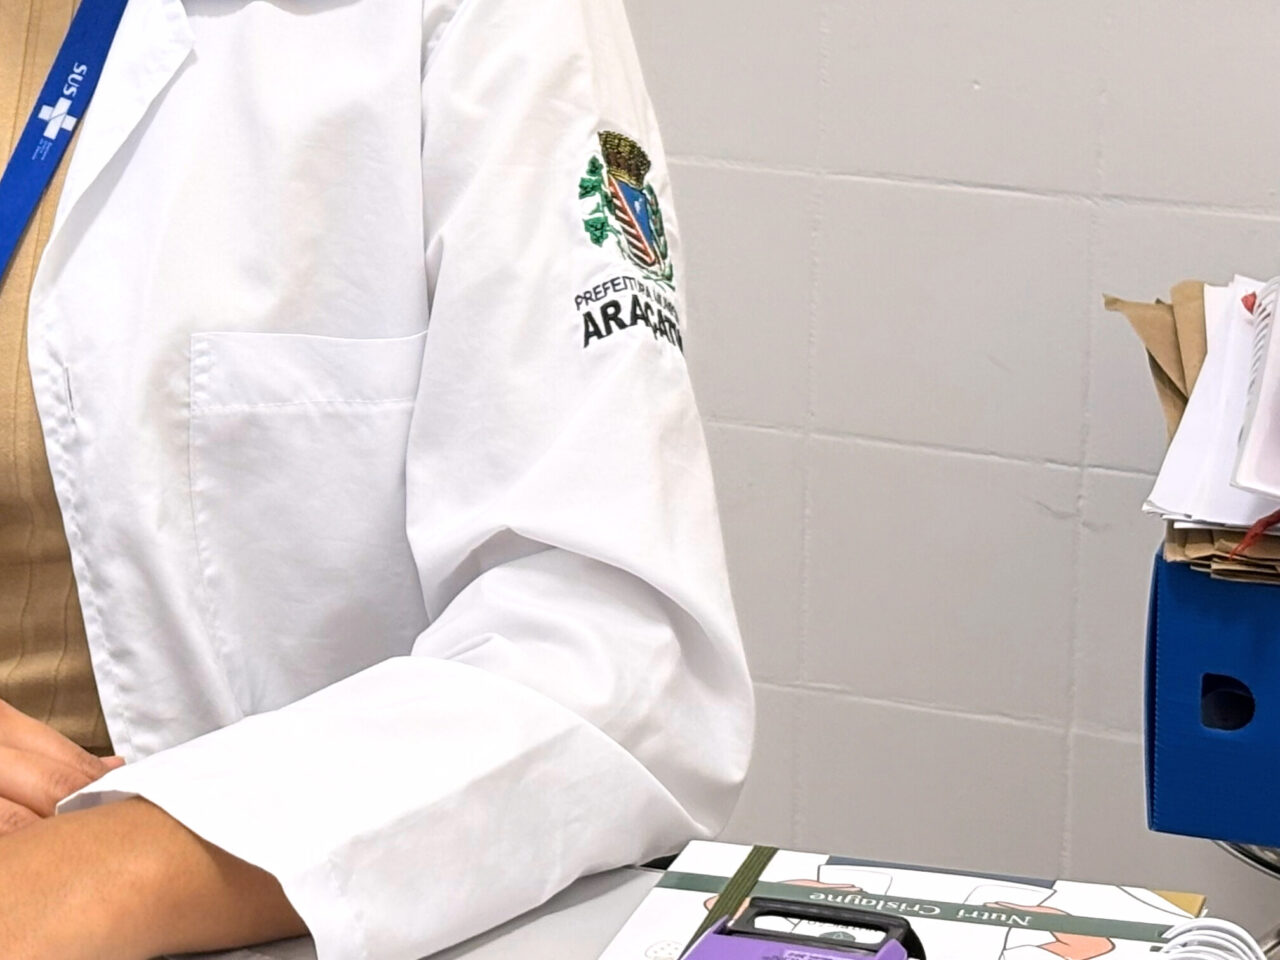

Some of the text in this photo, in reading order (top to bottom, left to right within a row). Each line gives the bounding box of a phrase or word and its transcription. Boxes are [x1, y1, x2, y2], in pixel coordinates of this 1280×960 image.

[63, 62, 88, 98] SUS
[810, 891, 1032, 927] Nutri Crislayne
